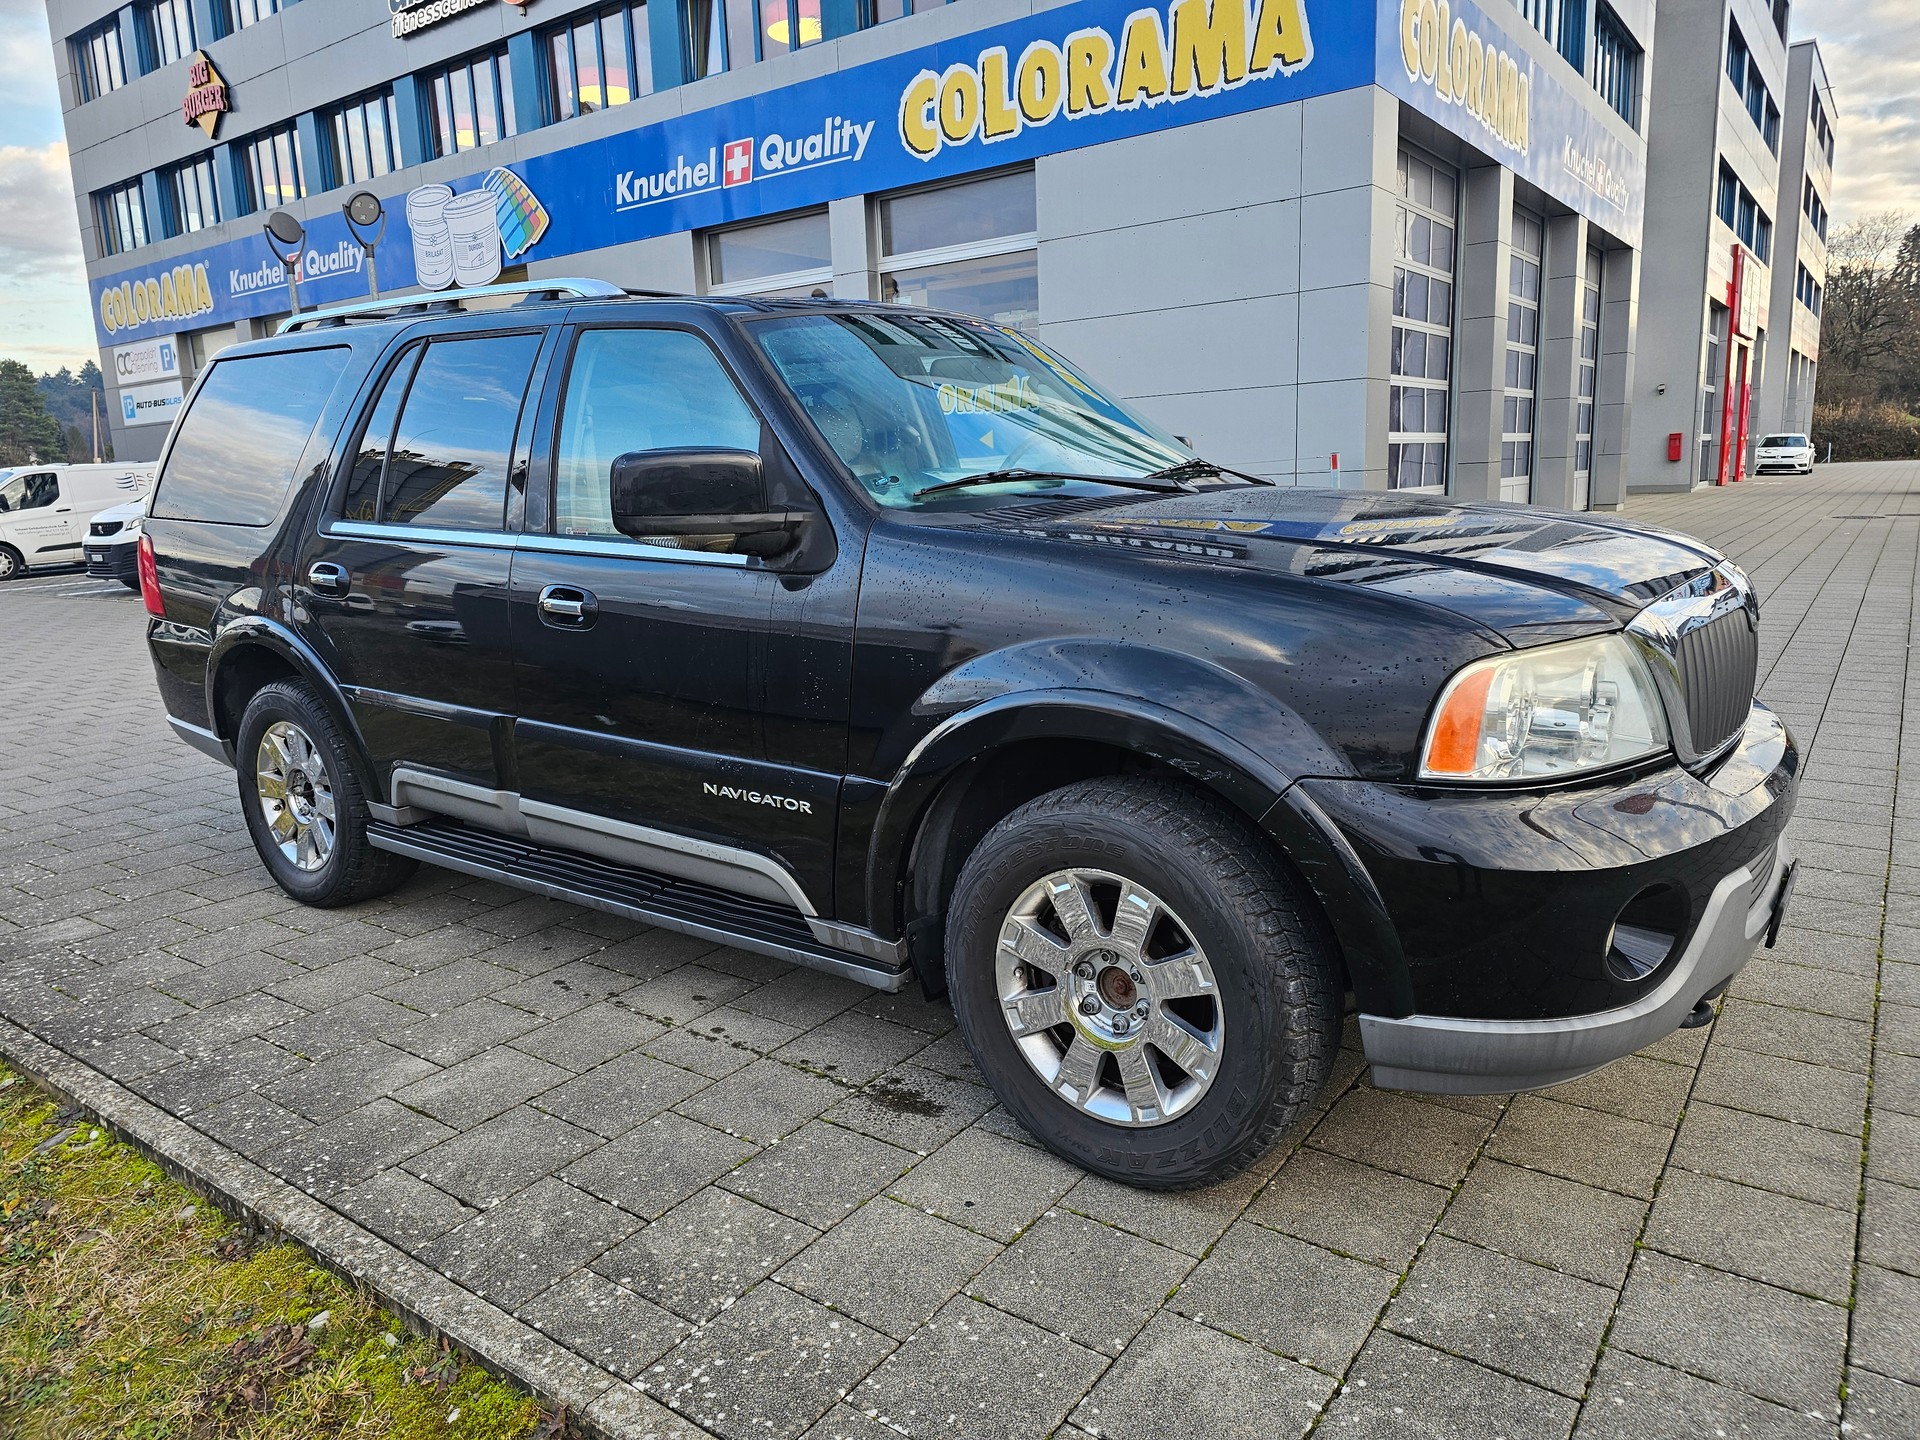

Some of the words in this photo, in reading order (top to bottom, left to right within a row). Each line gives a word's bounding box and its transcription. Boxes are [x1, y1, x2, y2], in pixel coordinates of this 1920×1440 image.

[182, 86, 224, 125] BURGER
[189, 61, 211, 88] BIG
[899, 0, 1314, 161] COLORAMA
[1400, 0, 1528, 157] COLORAMA
[616, 146, 716, 205] Knuchel
[759, 115, 876, 171] Quality
[1564, 134, 1597, 185] Knuchel
[229, 259, 285, 293] Knuchel
[305, 240, 365, 274] Quality
[101, 263, 214, 335] COLORAMA
[703, 782, 813, 815] NAVIGATOR
[1096, 1085, 1247, 1169] BLIZZAK
